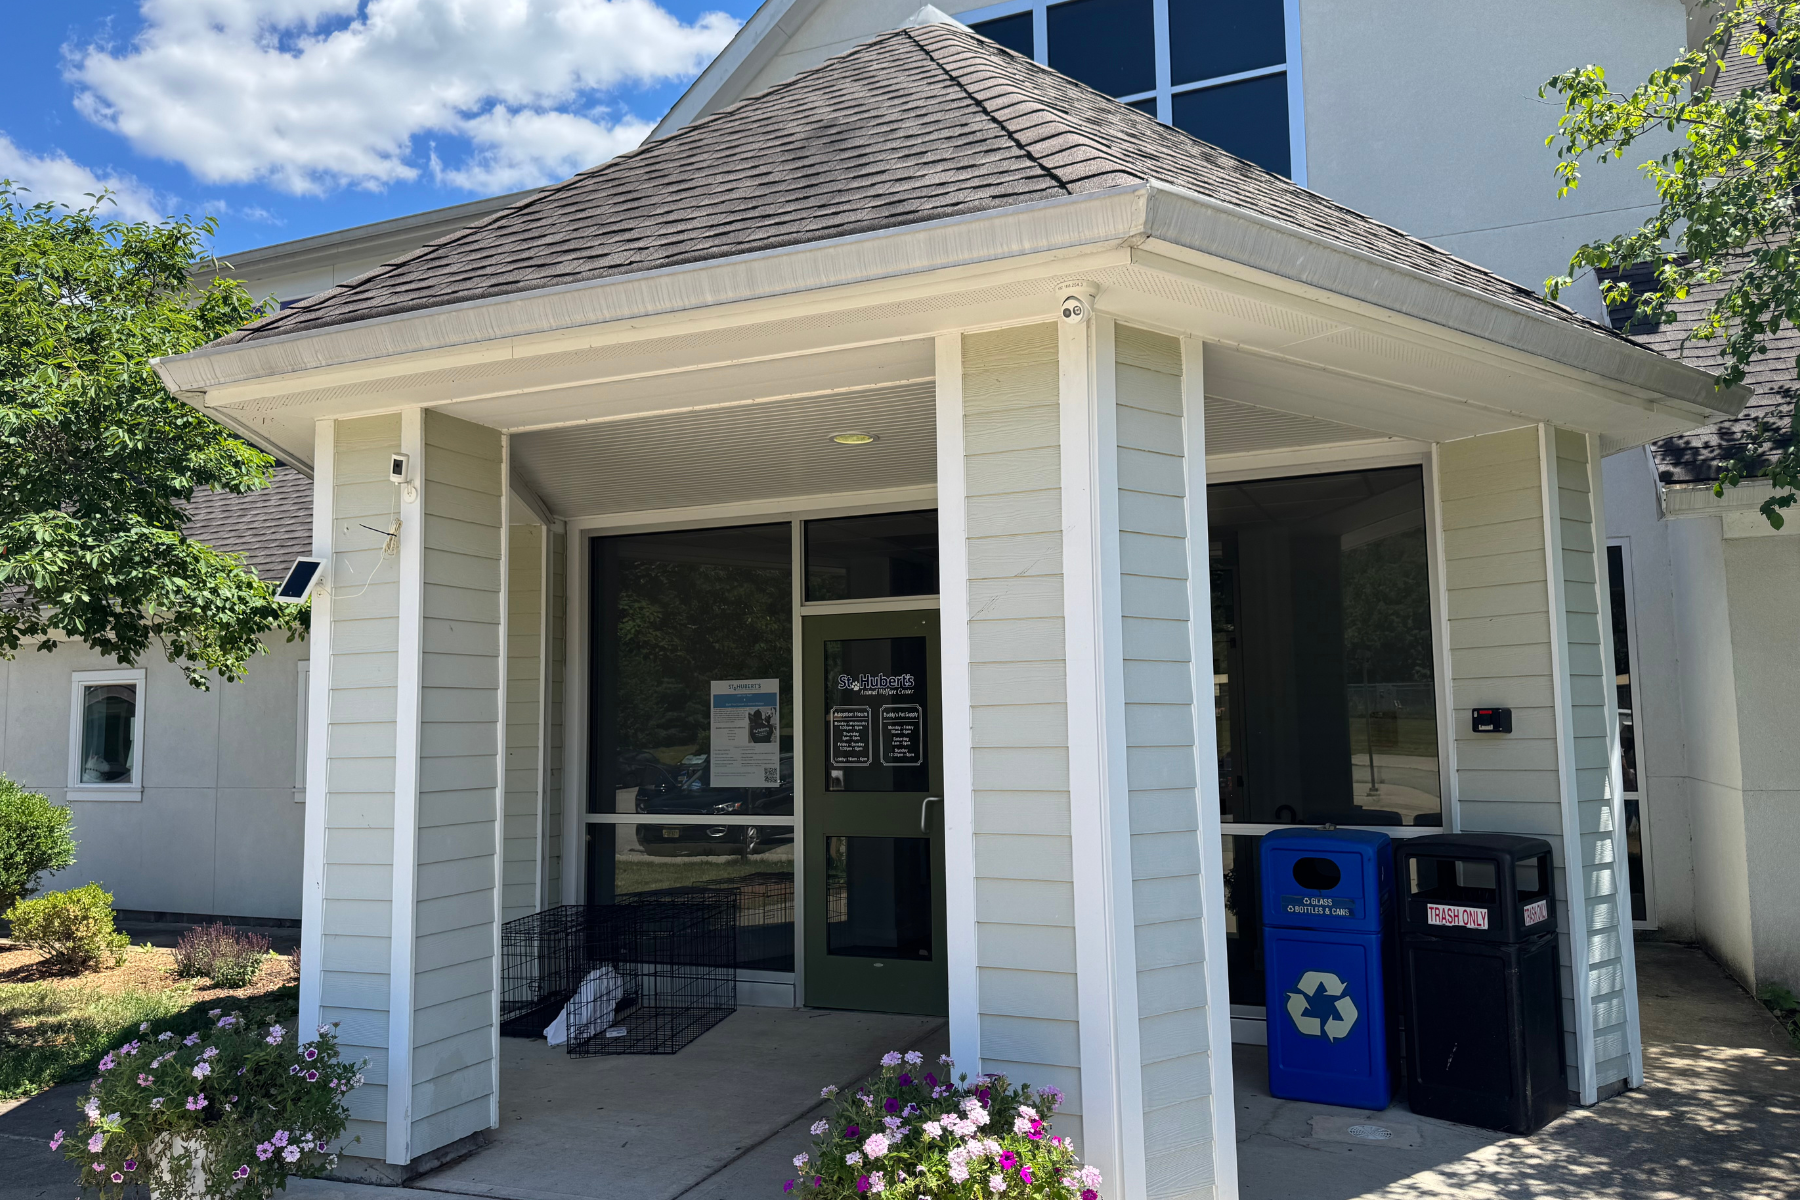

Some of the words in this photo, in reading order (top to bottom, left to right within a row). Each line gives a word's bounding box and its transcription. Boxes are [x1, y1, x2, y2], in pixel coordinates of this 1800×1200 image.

[860, 673, 914, 688] Hubert's
[1295, 906, 1323, 914] BOTTLES
[1428, 906, 1460, 924] TRASH
[1462, 909, 1486, 927] ONLY
[1524, 906, 1537, 924] TRASH
[1537, 903, 1547, 920] ONLY
